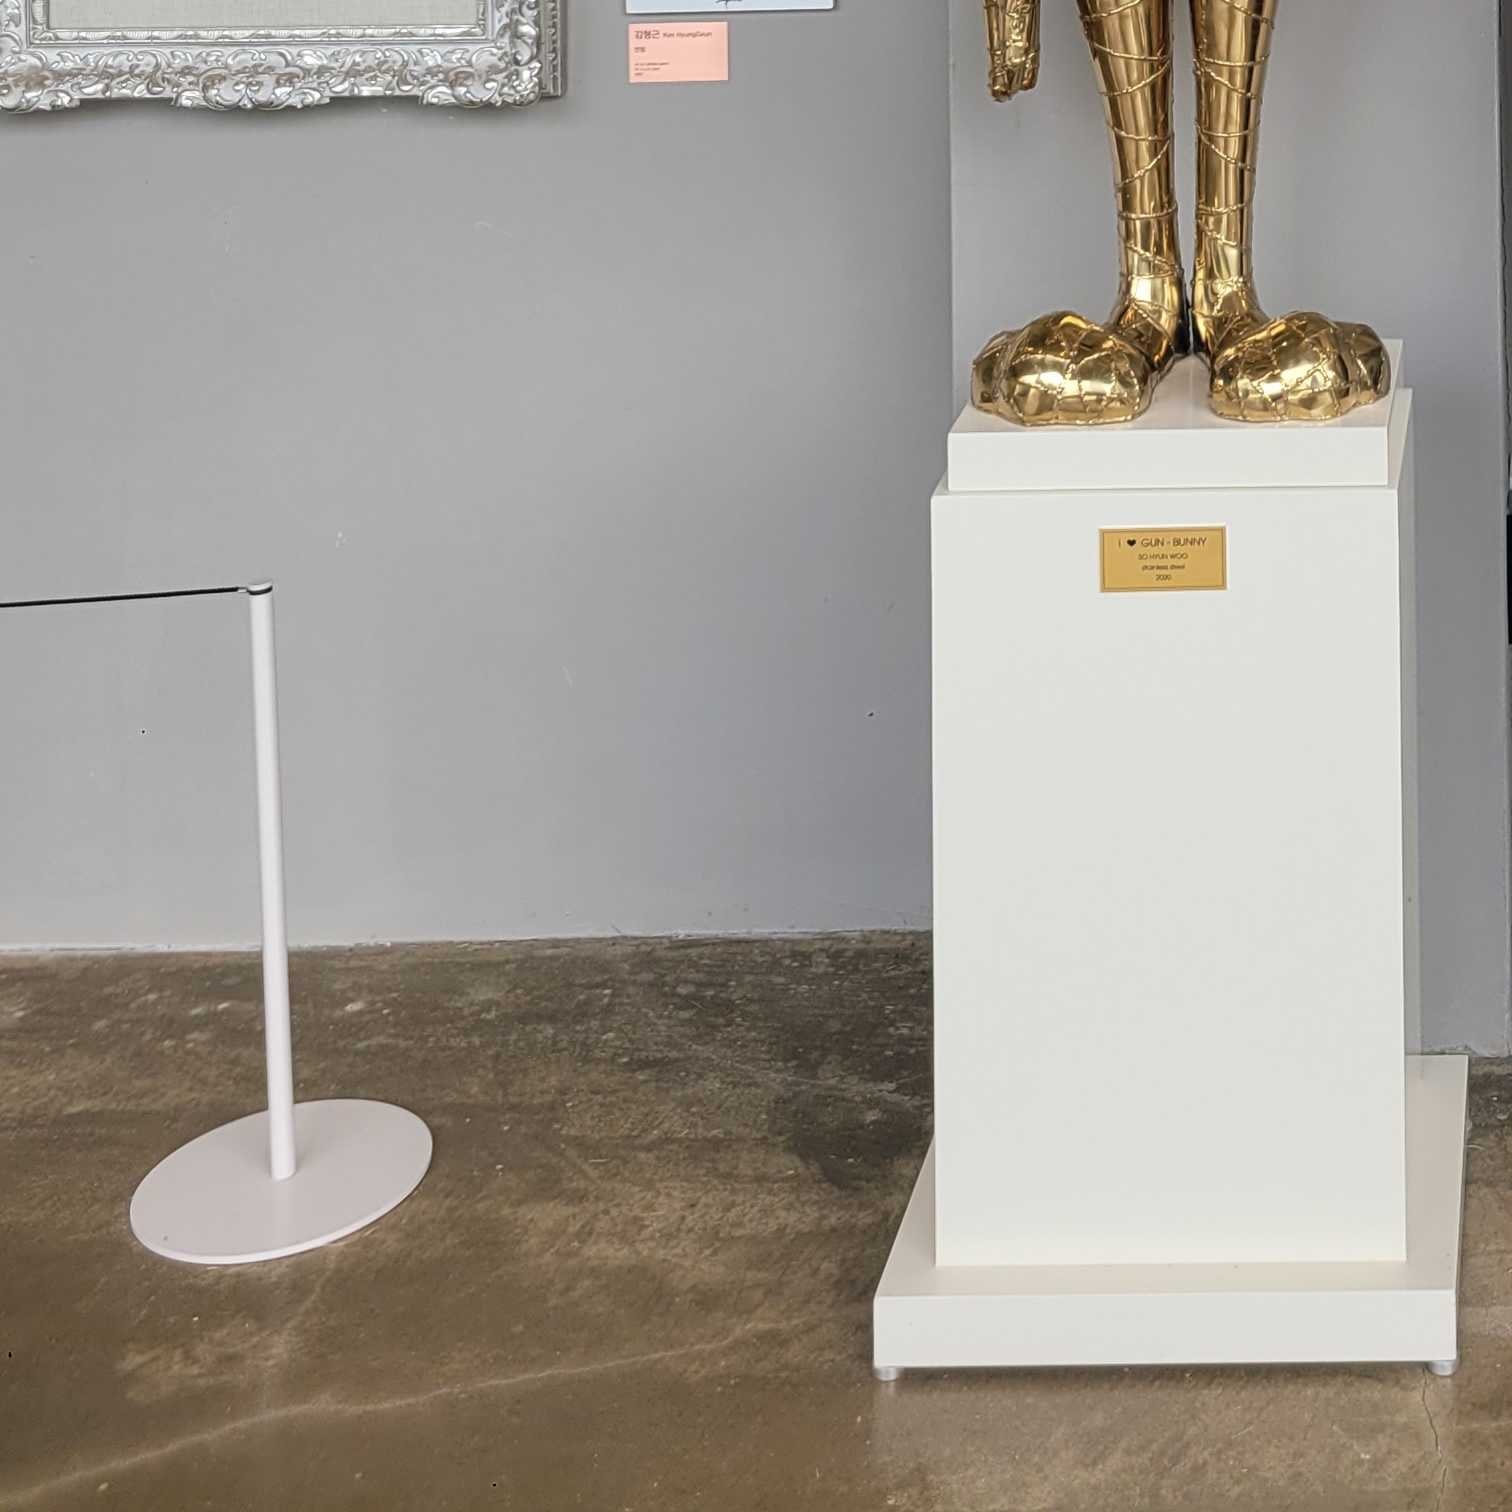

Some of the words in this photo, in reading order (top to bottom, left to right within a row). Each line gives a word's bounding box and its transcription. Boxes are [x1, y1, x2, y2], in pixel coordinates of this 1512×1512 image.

[634, 30, 660, 40] 김형근
[1141, 538, 1165, 547] GUN
[1173, 537, 1207, 547] BUNNY
